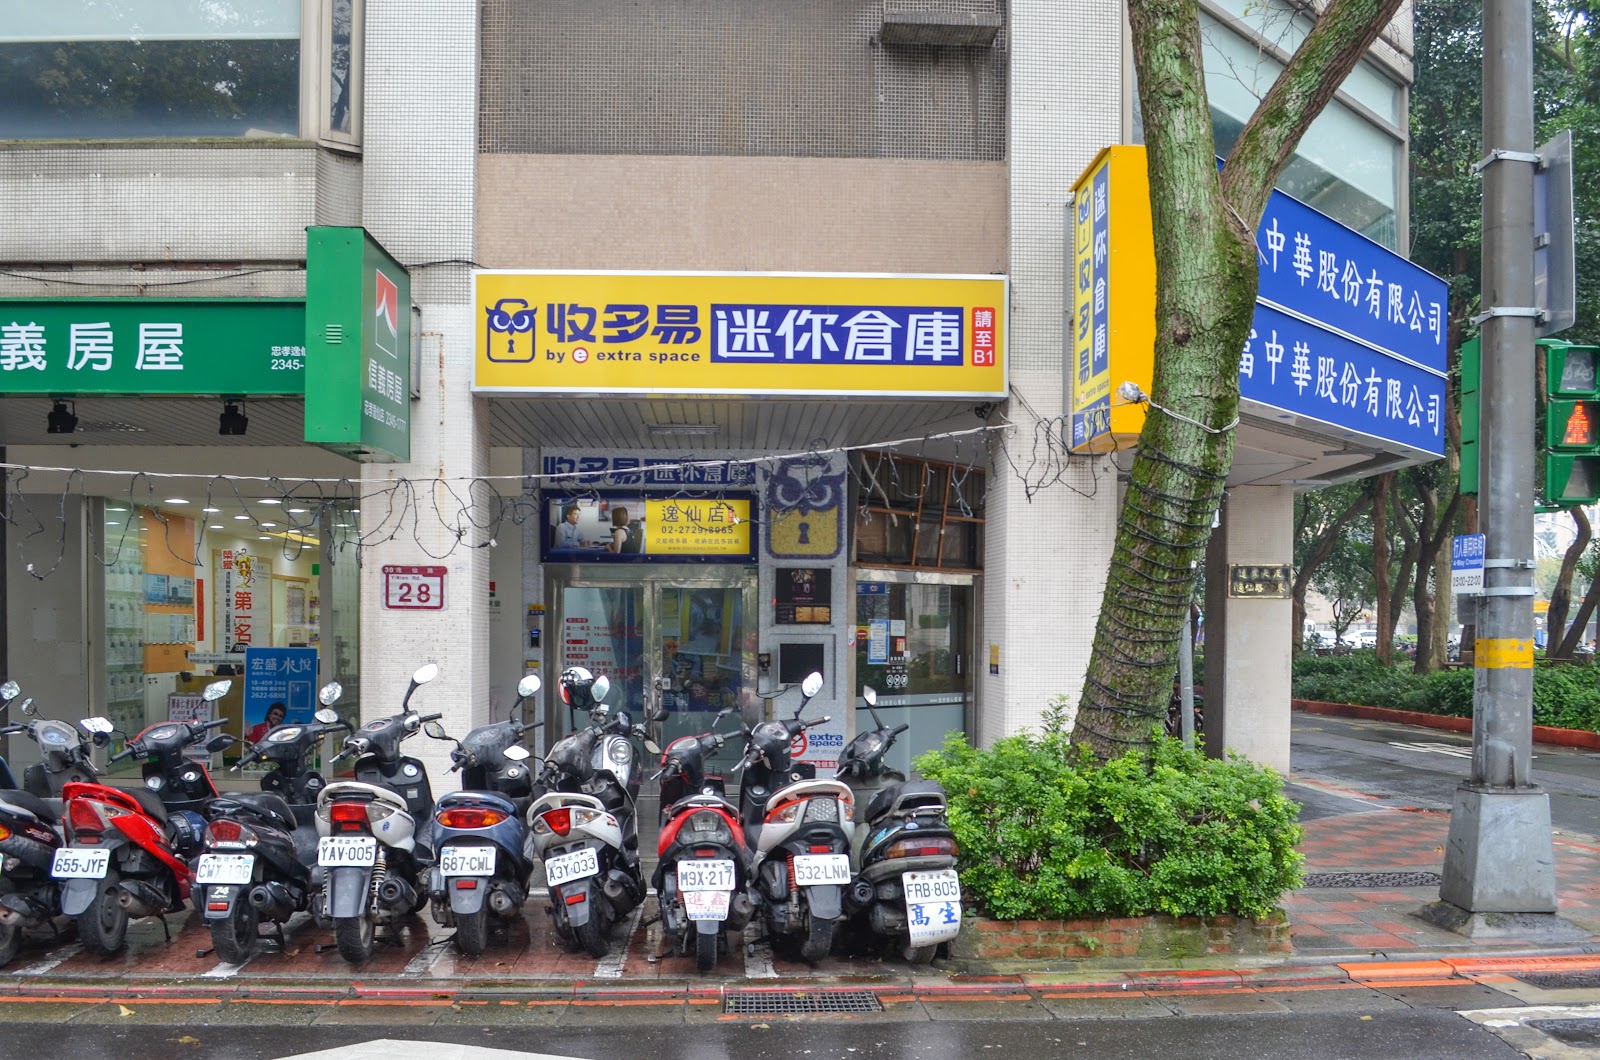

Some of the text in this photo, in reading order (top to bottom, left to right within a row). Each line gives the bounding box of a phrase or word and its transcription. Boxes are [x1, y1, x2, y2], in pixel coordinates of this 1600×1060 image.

[1094, 181, 1107, 363] 迷你倉庫
[1266, 217, 1441, 345] 中華股份有限公司
[546, 303, 701, 344] 收多易
[716, 309, 960, 362] 迷你倉庫
[1079, 256, 1091, 386] 收多易
[0, 321, 184, 371] 義房屋
[546, 349, 566, 364] by
[596, 349, 642, 362] extra
[649, 351, 700, 365] space
[368, 357, 403, 406] 信義房屋
[661, 505, 725, 522] 逸仙店
[235, 591, 252, 643] 第一名
[398, 583, 431, 603] 28
[809, 733, 843, 741] extra
[809, 740, 843, 748] space
